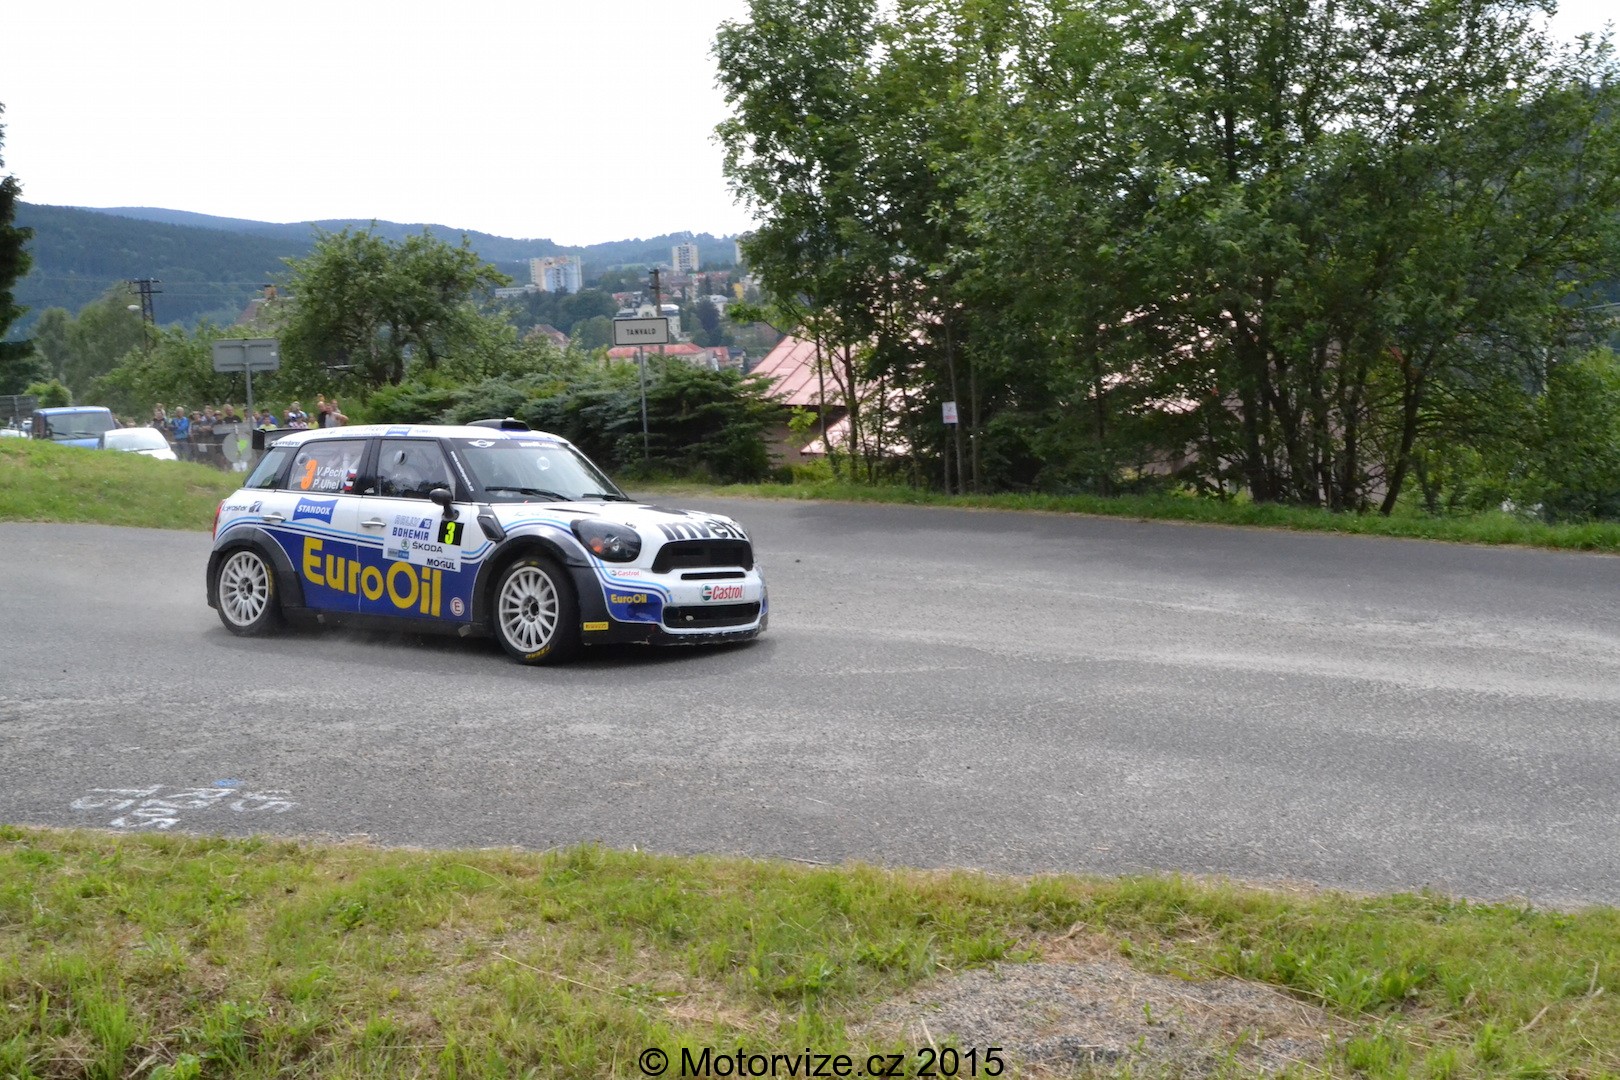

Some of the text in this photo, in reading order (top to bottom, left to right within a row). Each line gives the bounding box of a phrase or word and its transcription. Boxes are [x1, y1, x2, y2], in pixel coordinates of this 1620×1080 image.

[626, 328, 656, 336] TANVALD
[300, 459, 317, 490] 3
[297, 504, 332, 515] STANDOX
[392, 526, 430, 541] BOHEMIA
[444, 521, 456, 545] 3
[412, 541, 443, 553] ŠKODA
[427, 558, 456, 570] MOGUL
[302, 536, 442, 617] EuroOil
[610, 593, 647, 604] EuroOil
[713, 585, 743, 600] Castrol
